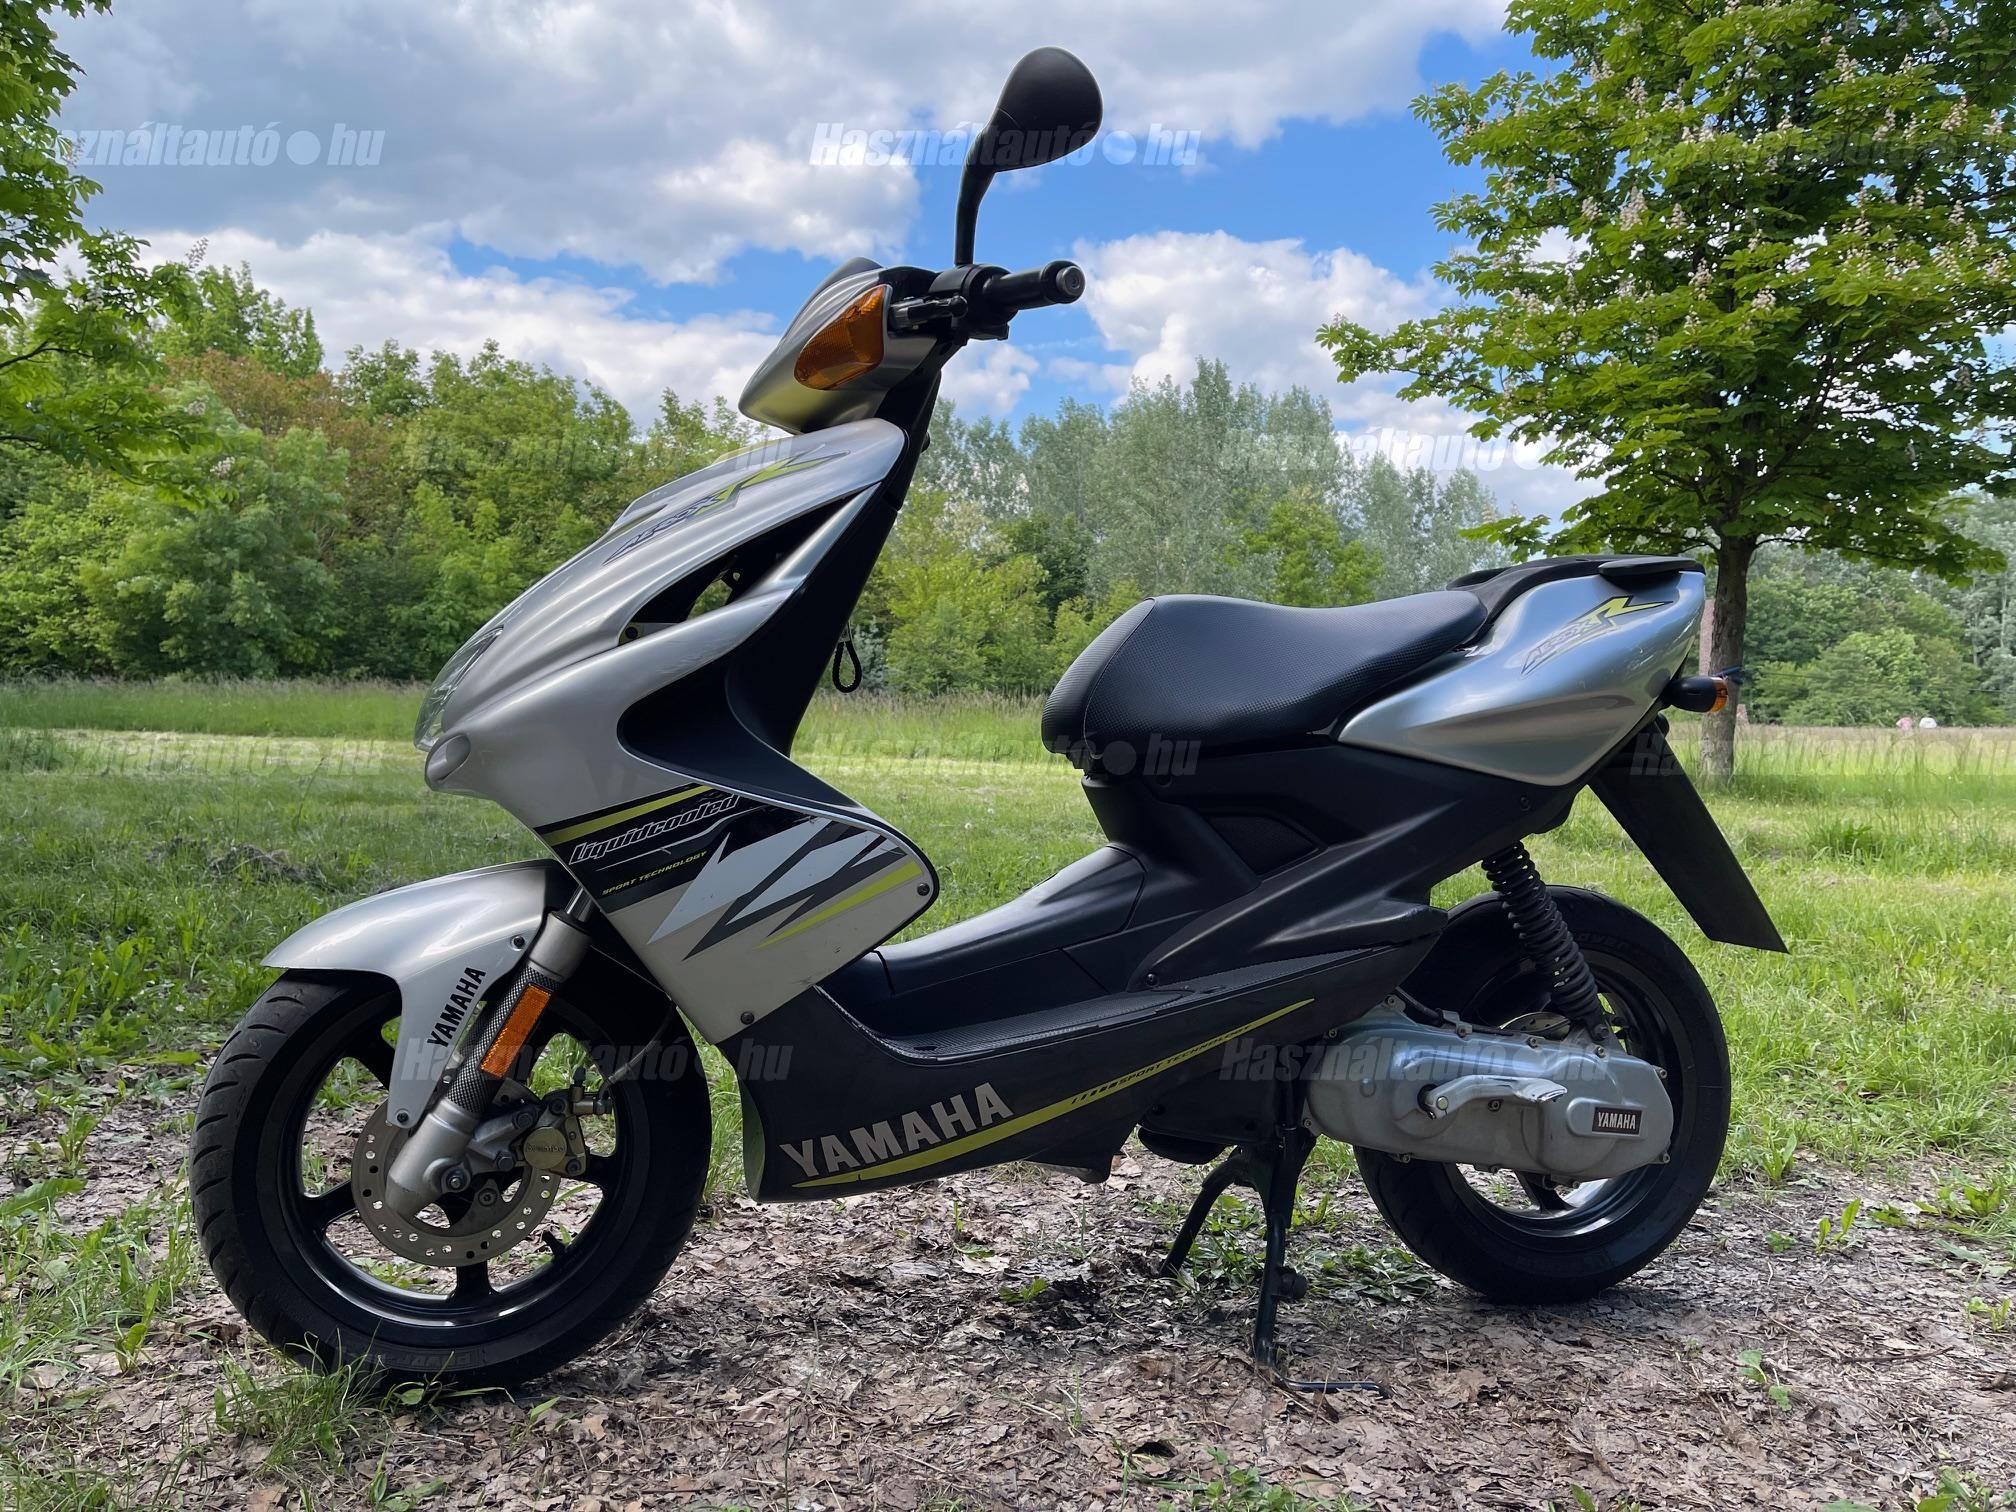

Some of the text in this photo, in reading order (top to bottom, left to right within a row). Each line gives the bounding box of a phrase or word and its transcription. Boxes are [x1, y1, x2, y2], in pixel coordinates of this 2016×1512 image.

[602, 851, 707, 896] SPORT TECHNOLOGY
[427, 967, 486, 1047] YAMAHA
[1118, 1064, 1162, 1084] SPORT
[779, 1082, 1014, 1178] YAMAHA
[1598, 1112, 1636, 1130] YAMAHA
